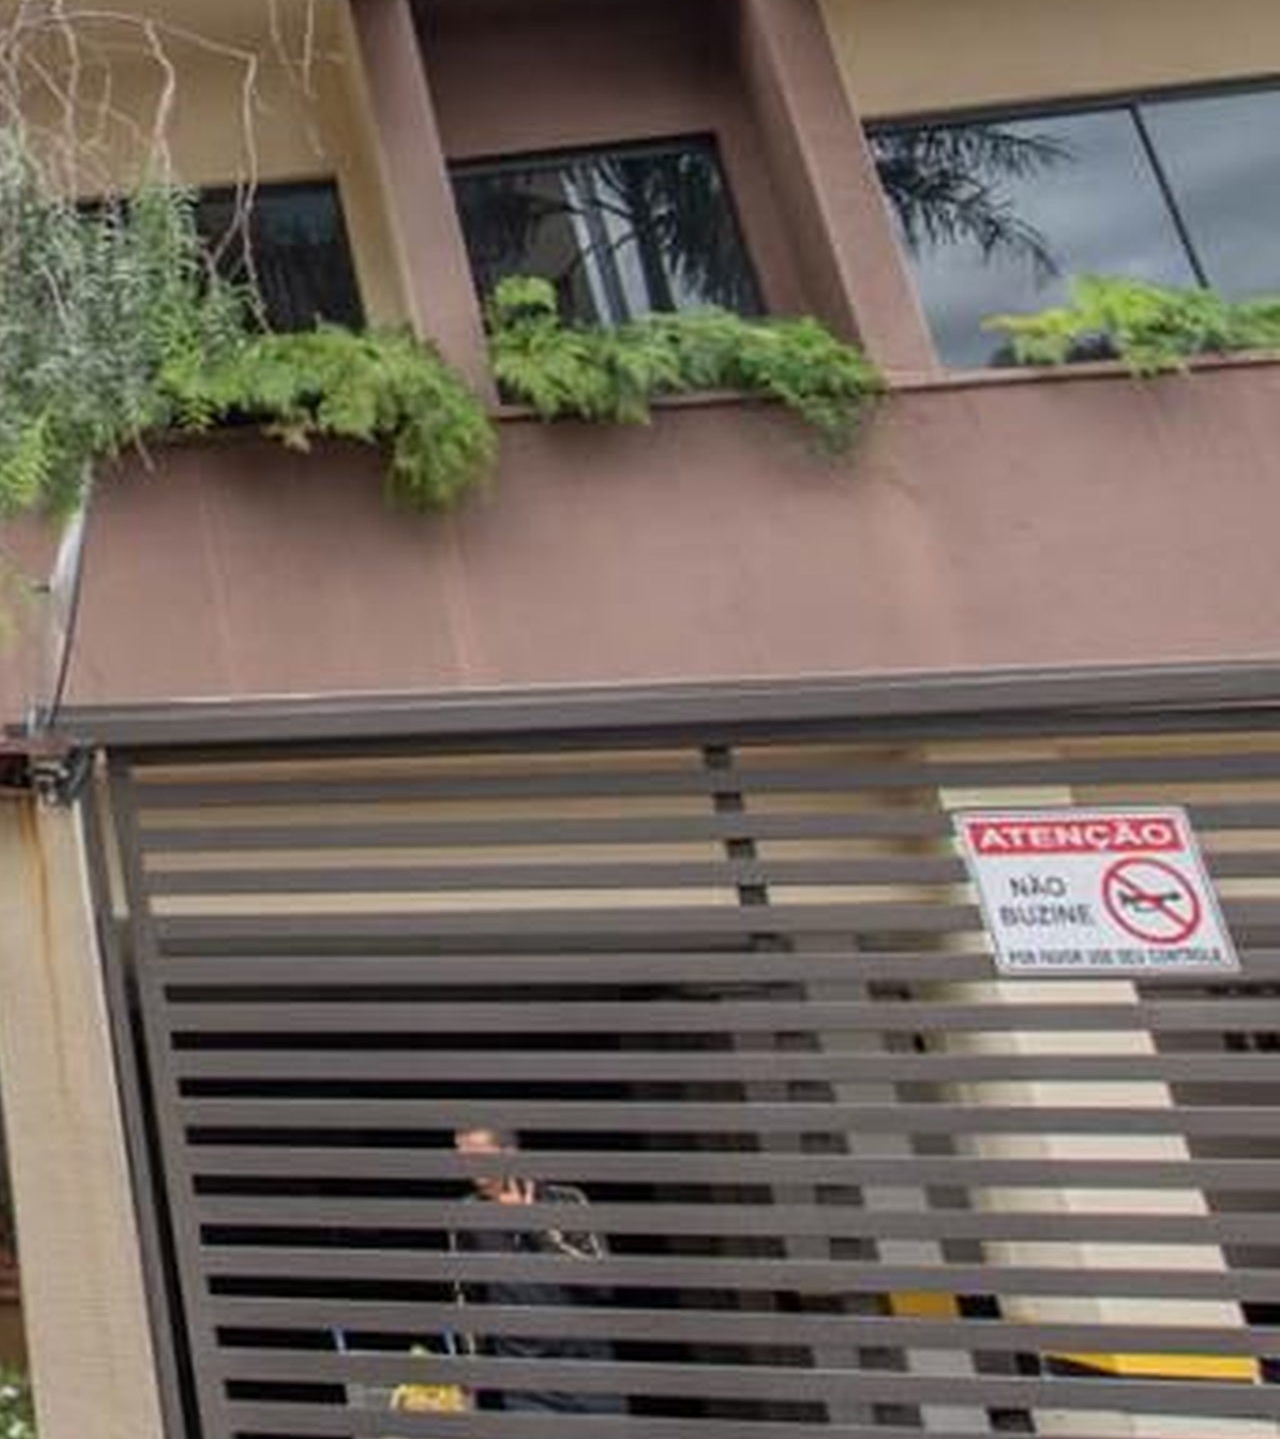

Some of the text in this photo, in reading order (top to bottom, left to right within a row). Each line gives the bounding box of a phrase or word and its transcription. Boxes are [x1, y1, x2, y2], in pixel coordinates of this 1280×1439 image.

[979, 818, 1173, 851] ATENÇÃO
[1009, 874, 1067, 898] NÃO
[998, 904, 1093, 926] BUZINE
